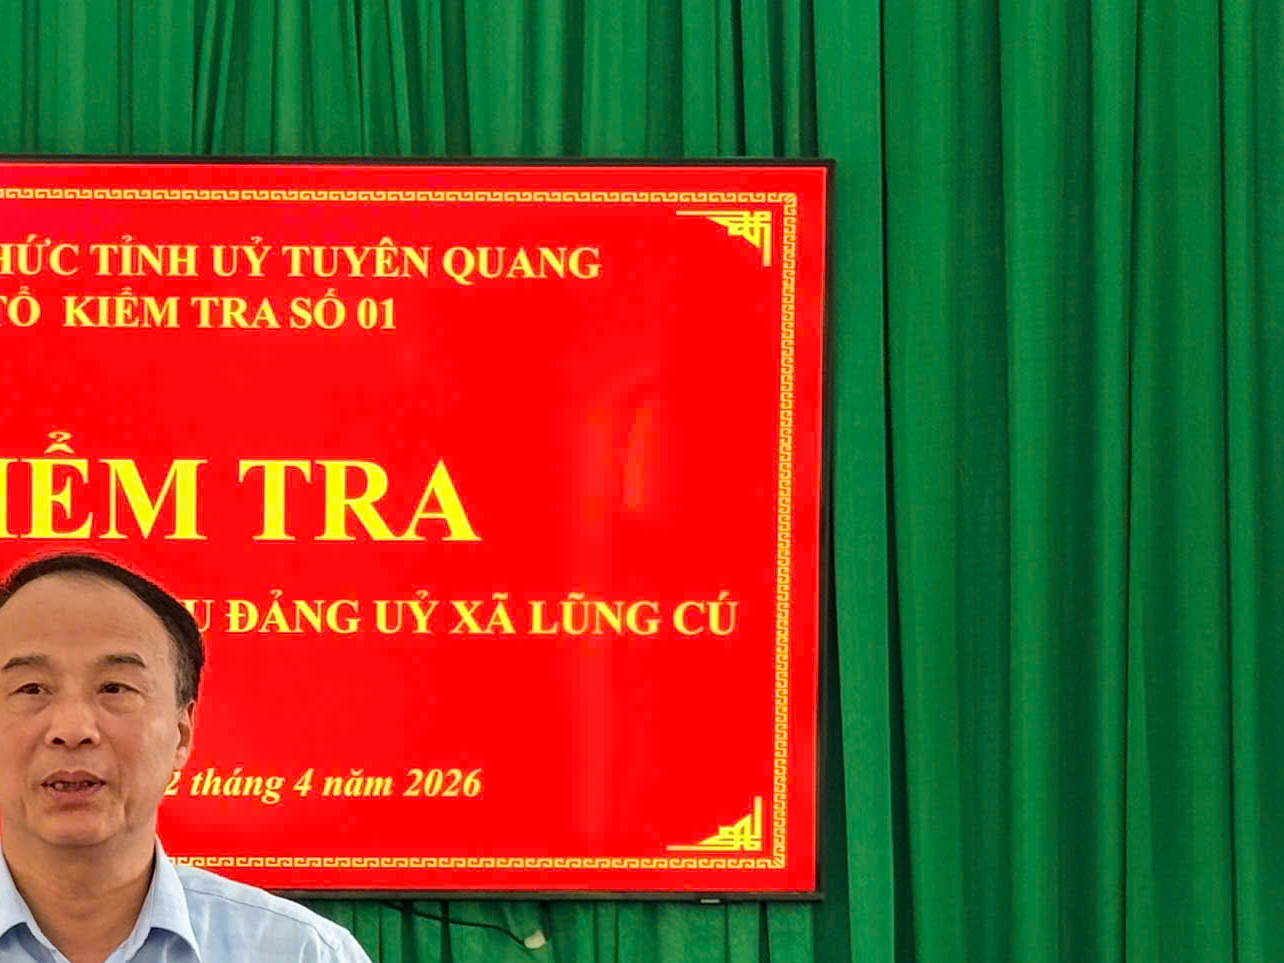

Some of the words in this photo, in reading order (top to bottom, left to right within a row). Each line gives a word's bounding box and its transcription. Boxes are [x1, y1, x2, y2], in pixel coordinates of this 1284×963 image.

[90, 234, 199, 276] TỈNH
[212, 236, 272, 277] UỶ
[282, 237, 431, 278] TUYÊN
[443, 246, 601, 285] QUANG
[63, 287, 180, 328] KIỂM
[191, 297, 281, 329] TRA
[290, 288, 346, 330] SỐ
[357, 298, 397, 330] 01
[239, 460, 482, 542] TRA
[225, 588, 360, 635] ĐẢNG
[373, 590, 439, 634] UỶ
[451, 592, 517, 635] XÃ
[530, 592, 661, 636] LŨNG
[672, 592, 738, 636] CÚ
[191, 767, 284, 804] tháng
[293, 768, 314, 797] 4
[322, 769, 393, 797] năm
[404, 768, 482, 798] 2026
